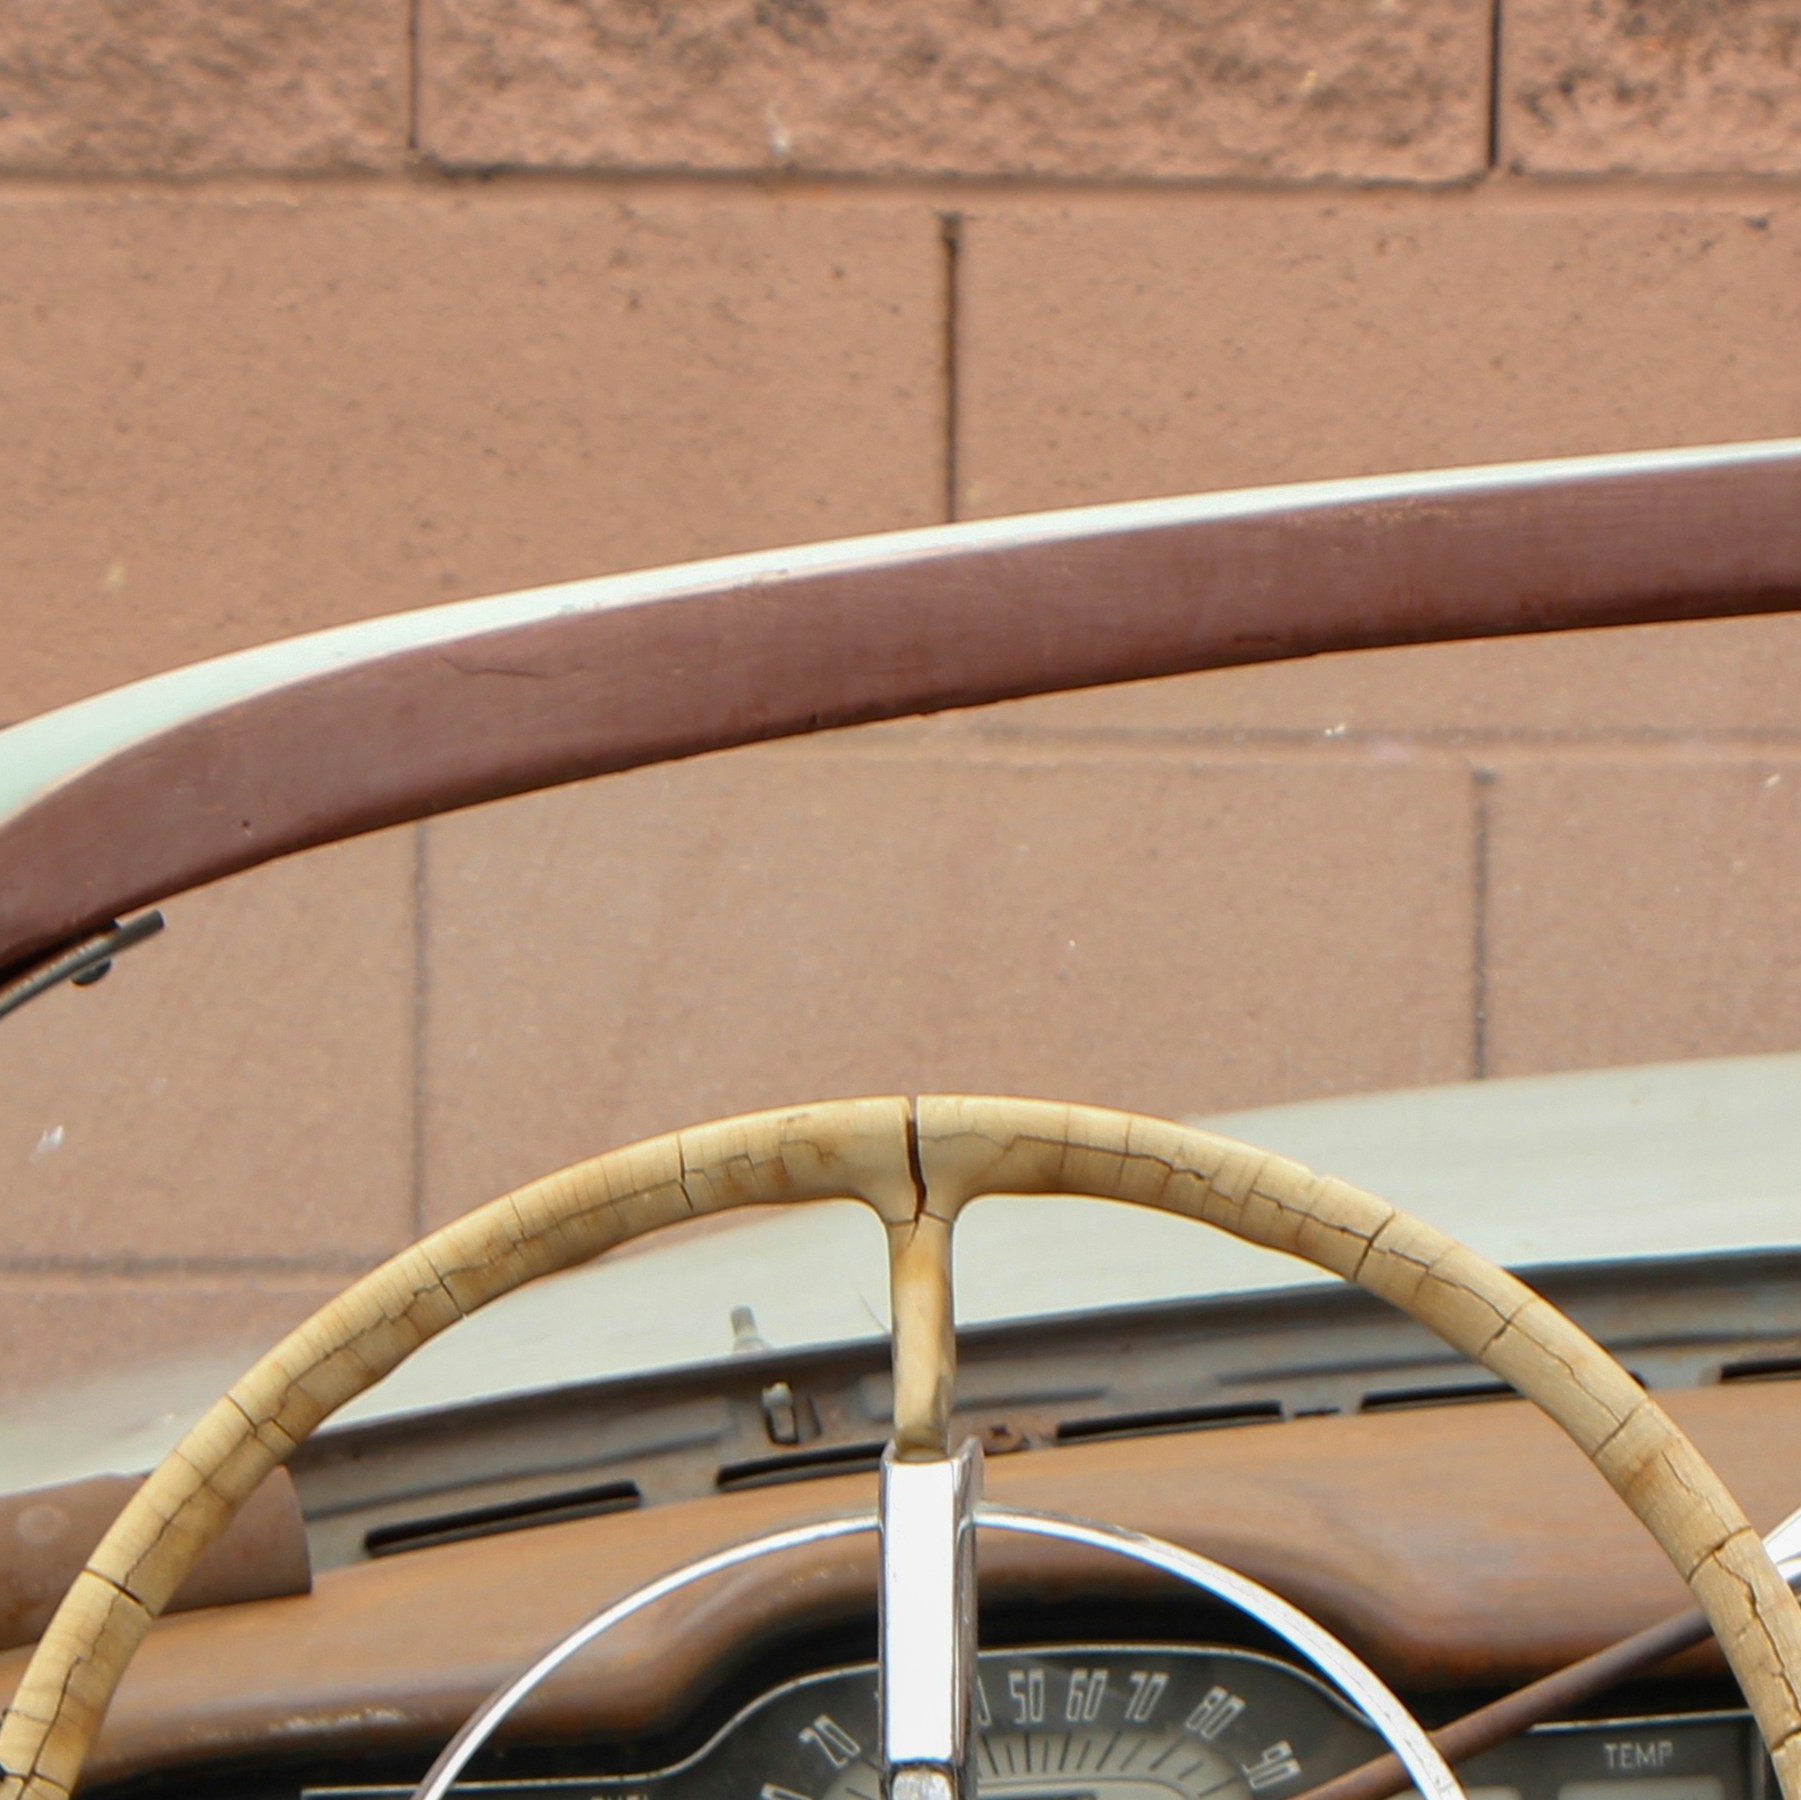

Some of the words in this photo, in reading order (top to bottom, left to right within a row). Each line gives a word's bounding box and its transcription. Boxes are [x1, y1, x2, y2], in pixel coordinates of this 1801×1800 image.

[798, 1714, 862, 1769] 20
[1008, 1669, 1045, 1724] 50
[1065, 1668, 1109, 1722] 60
[1125, 1671, 1170, 1722] 70
[1185, 1685, 1247, 1740] 80
[1241, 1740, 1301, 1790] 90
[1603, 1740, 1674, 1769] TEMP
